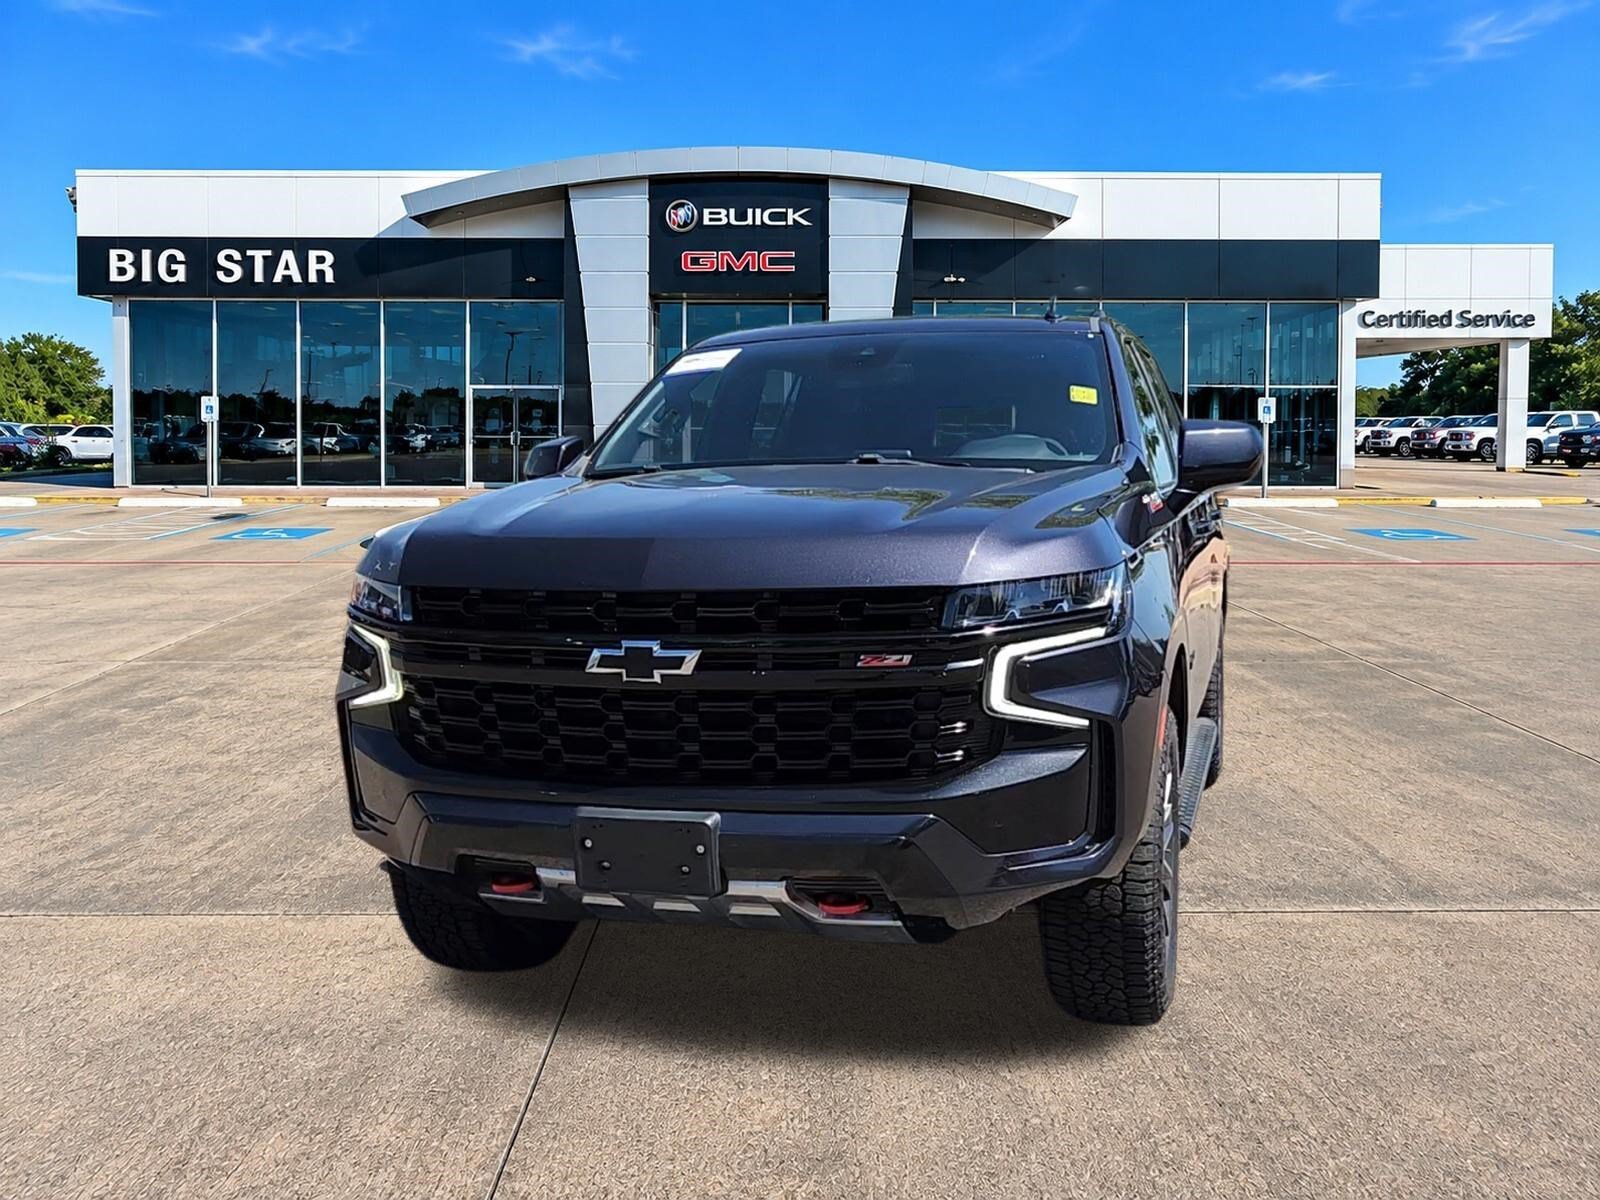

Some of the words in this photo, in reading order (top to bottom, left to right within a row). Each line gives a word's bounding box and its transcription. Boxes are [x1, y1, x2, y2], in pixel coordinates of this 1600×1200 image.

[703, 208, 813, 226] BUICK
[108, 248, 187, 283] BIG
[215, 248, 336, 284] STAR
[681, 251, 796, 272] GMC
[1360, 310, 1453, 328] Certified
[1456, 309, 1536, 328] Service
